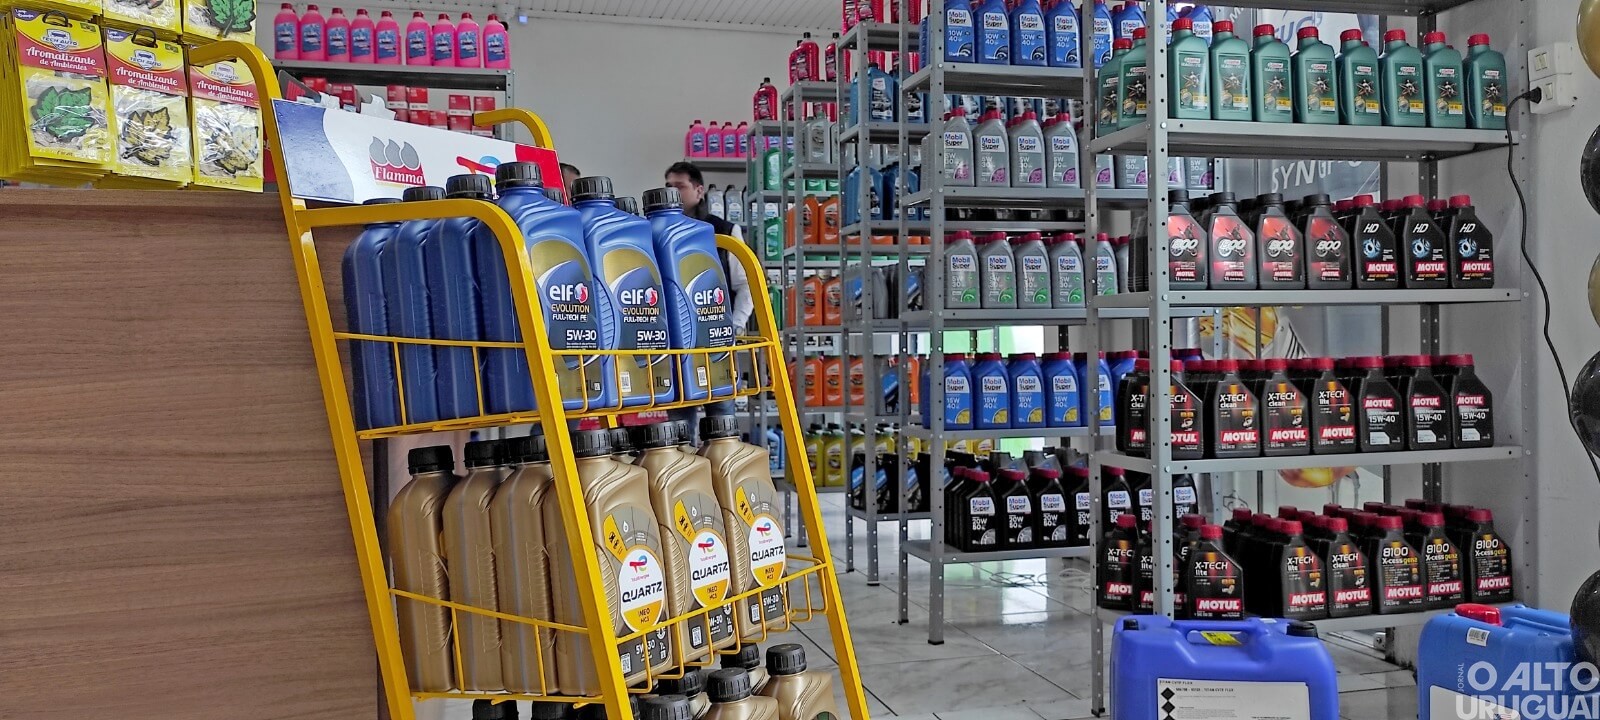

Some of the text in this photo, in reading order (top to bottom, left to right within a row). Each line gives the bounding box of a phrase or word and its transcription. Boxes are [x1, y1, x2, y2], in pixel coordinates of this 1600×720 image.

[985, 13, 1003, 21] Mobil
[1021, 21, 1038, 29] Super
[26, 47, 96, 65] Aromatizante
[50, 60, 87, 70] Ambientes
[116, 67, 177, 85] Aromatizante
[138, 80, 170, 90] Ambientes
[197, 80, 254, 98] Aromatizante
[217, 92, 247, 102] Ambientes
[945, 133, 962, 141] Mobil
[375, 166, 424, 184] Flamma
[1363, 223, 1379, 233] HD
[1413, 223, 1428, 233] HD
[1459, 223, 1475, 233] HD
[1171, 239, 1198, 249] 800
[1218, 239, 1246, 250] 800
[1269, 239, 1294, 250] 800
[1316, 241, 1341, 250] 800
[1368, 263, 1395, 272] MOTUL
[1417, 263, 1445, 271] MOTUL
[1464, 262, 1490, 271] MOTUL
[550, 284, 572, 300] elf
[621, 289, 644, 305] elf
[695, 290, 712, 305] elf
[551, 304, 589, 313] EVOLUTION
[623, 307, 659, 315] EVOLUTION
[697, 306, 725, 315] EVOLUTION
[566, 330, 596, 340] 5W-30
[637, 330, 666, 341] 5W-30
[709, 327, 732, 338] 5W-30
[1220, 394, 1247, 402] X-TECH
[1318, 390, 1345, 398] X-TECH
[1365, 399, 1393, 407] MOTUL
[1457, 396, 1484, 404] MOTUL
[1223, 431, 1256, 440] MOTUL
[1272, 430, 1305, 439] MOTUL
[1322, 428, 1354, 436] MOTUL
[1176, 495, 1192, 503] Super
[1426, 544, 1449, 554] 8100
[1476, 539, 1498, 549] 8100
[752, 545, 783, 562] QUARTZ
[1383, 547, 1408, 557] 8100
[1475, 549, 1494, 557] X-cess
[1287, 556, 1314, 564] X-TECH
[1332, 553, 1359, 563] X-TECH
[693, 562, 728, 580] QUARTZ
[1195, 562, 1228, 570] X-TECH
[1430, 582, 1460, 592] MOTUL
[1479, 578, 1510, 587] MOTUL
[622, 581, 662, 603] QUARTZ
[1336, 591, 1368, 600] MOTUL
[1387, 587, 1421, 596] MOTUL
[764, 595, 779, 607] 5W-30
[1291, 594, 1324, 604] MOTUL
[1199, 600, 1239, 609] MOTUL
